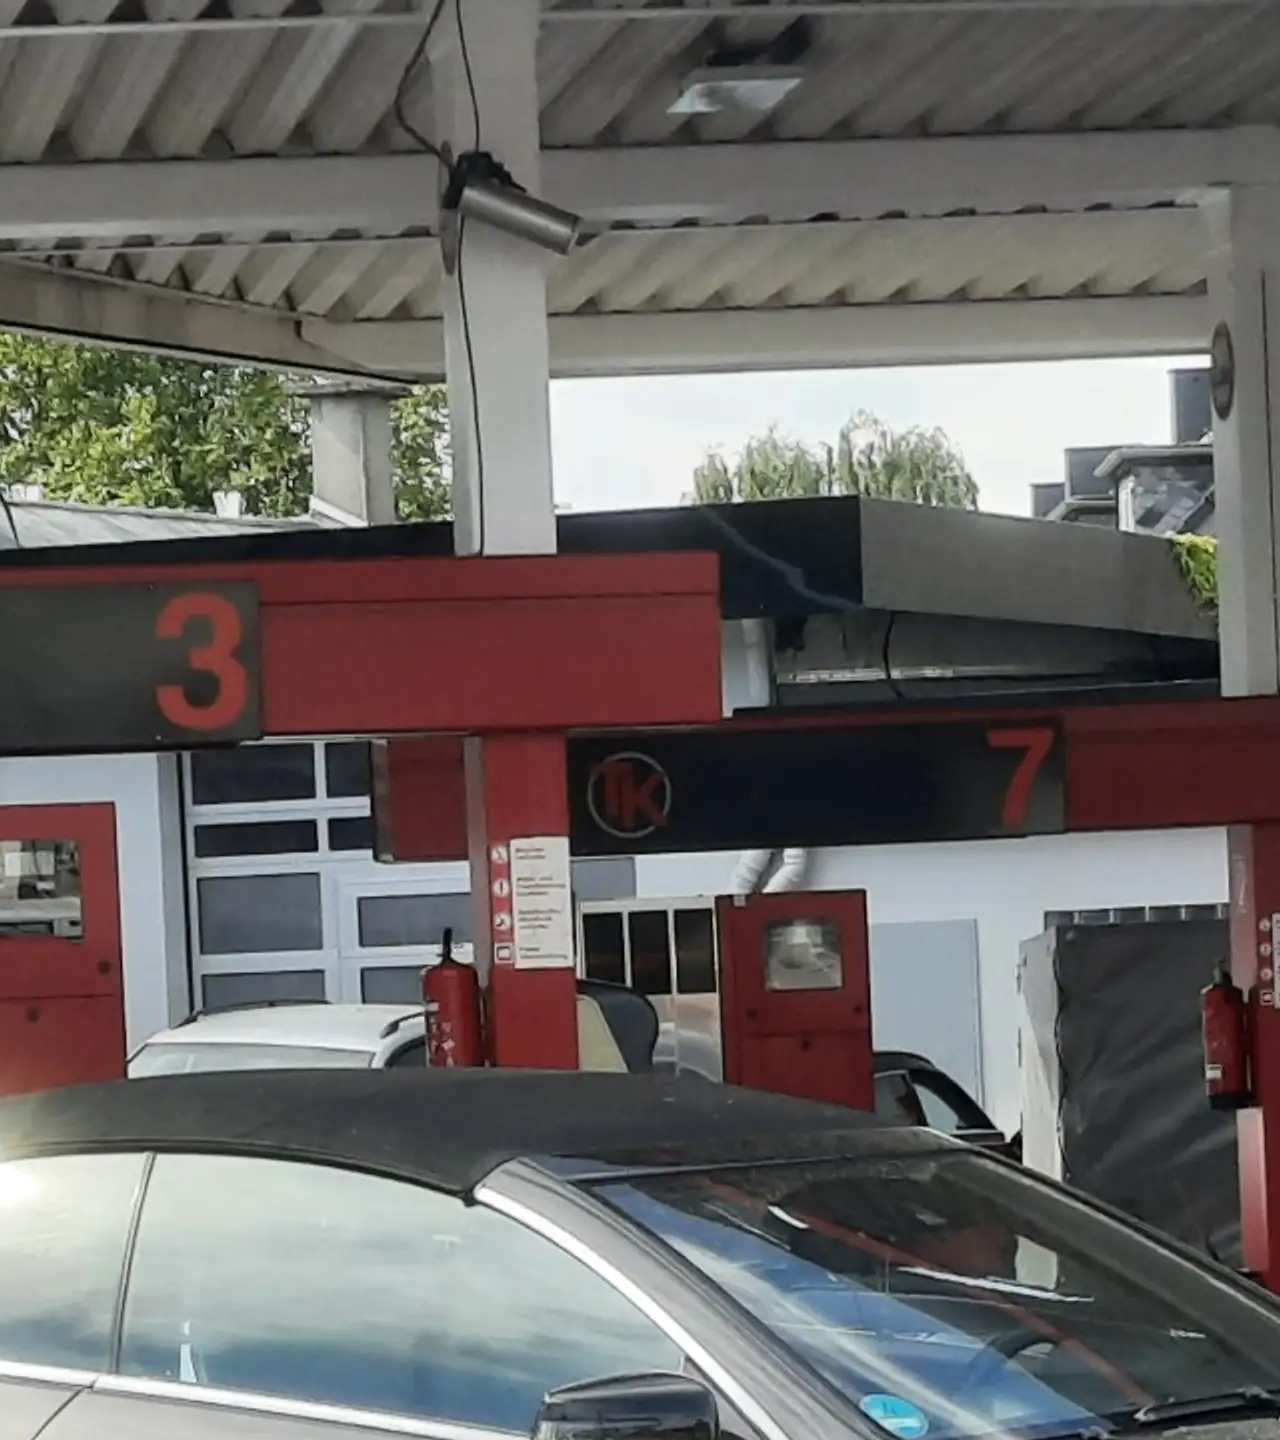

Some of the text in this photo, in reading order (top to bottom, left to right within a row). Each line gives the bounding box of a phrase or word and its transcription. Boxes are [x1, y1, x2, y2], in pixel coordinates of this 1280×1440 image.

[155, 591, 247, 731] 3
[590, 760, 668, 829] TK
[987, 727, 1053, 826] 7
